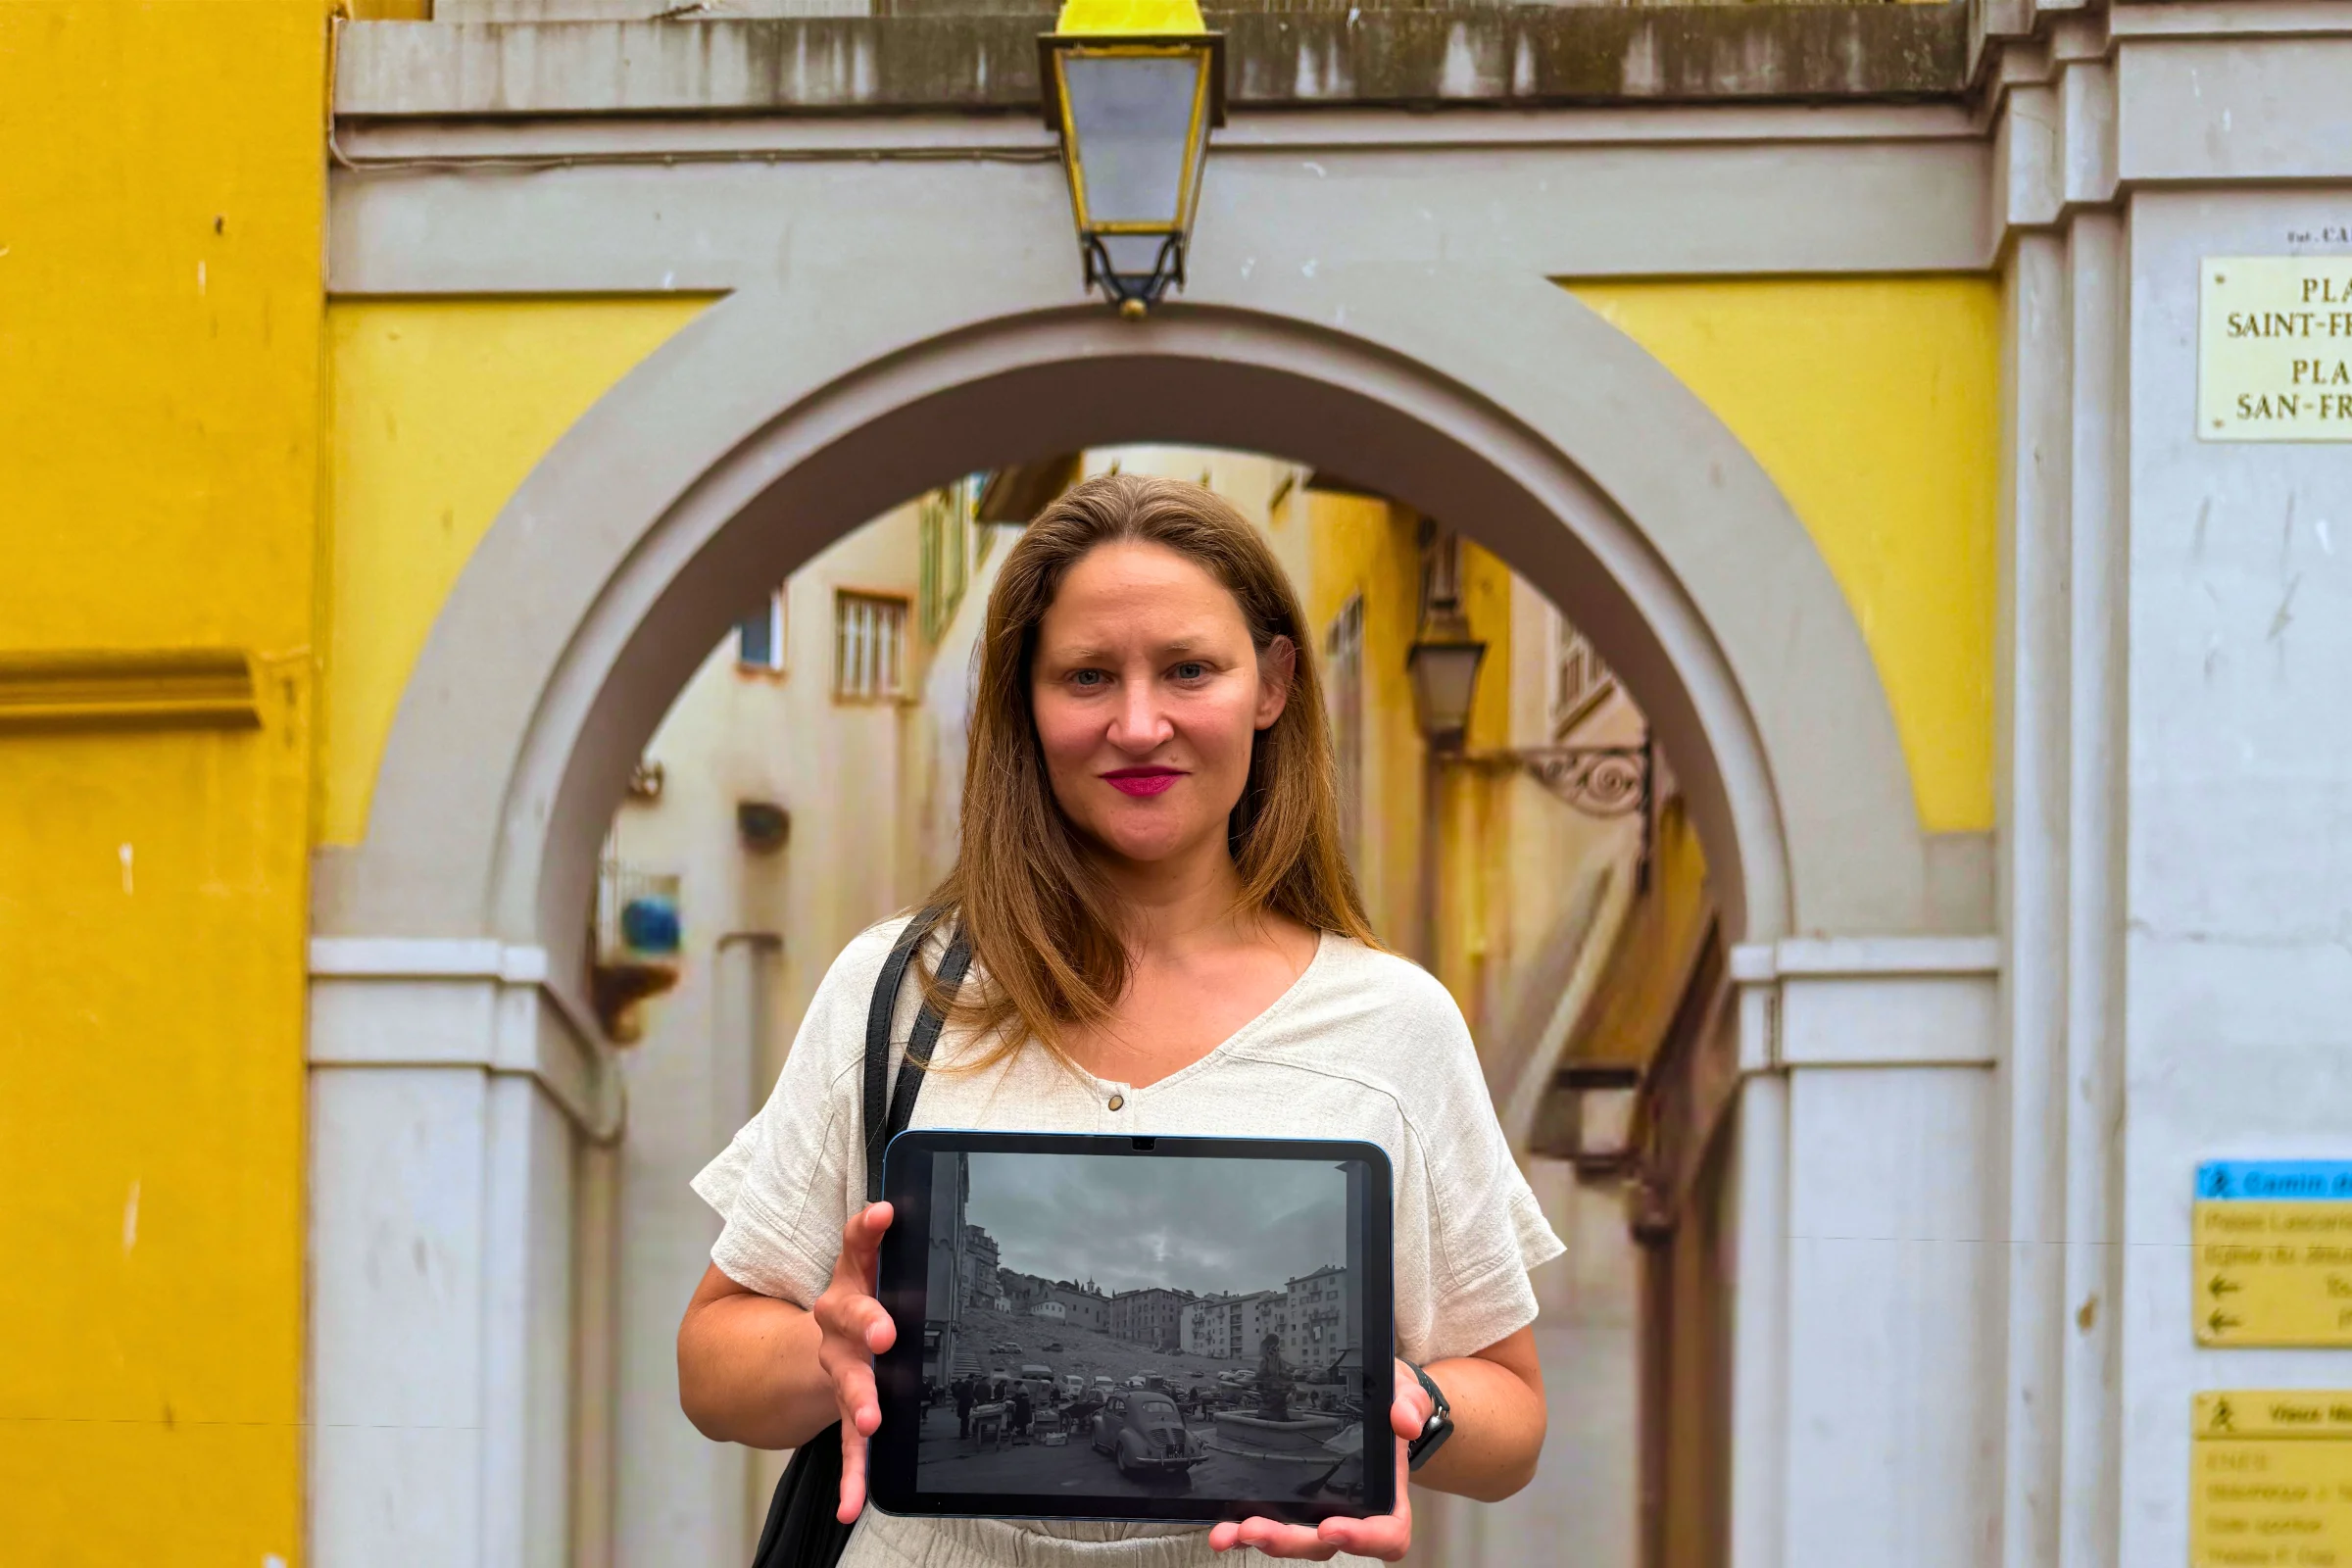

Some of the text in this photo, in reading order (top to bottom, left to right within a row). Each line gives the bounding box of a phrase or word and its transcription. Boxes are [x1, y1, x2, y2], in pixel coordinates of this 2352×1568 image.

[2302, 278, 2352, 303] PLA
[2292, 359, 2350, 384] PLA
[2236, 393, 2352, 419] SAN-FR
